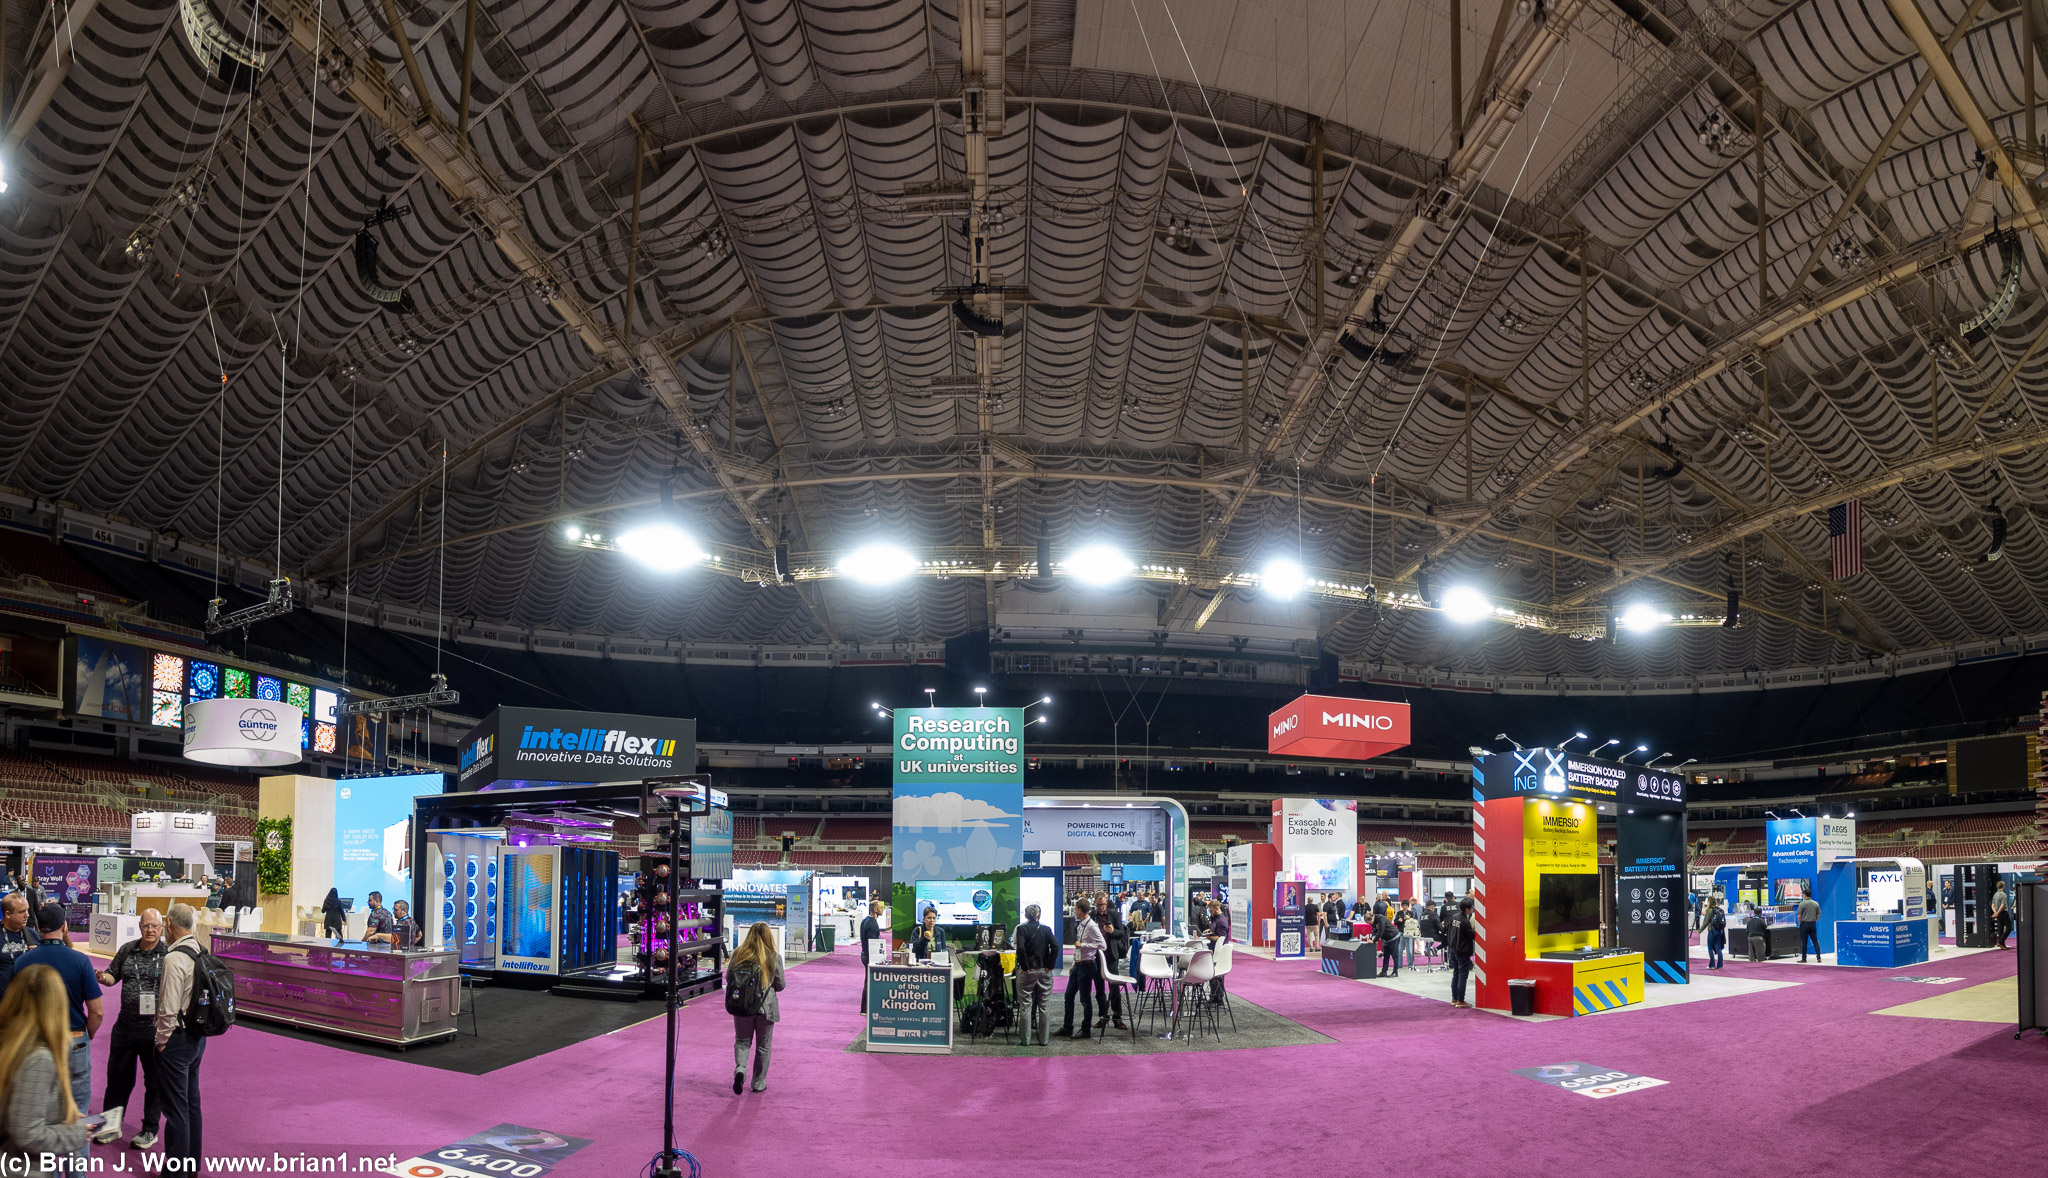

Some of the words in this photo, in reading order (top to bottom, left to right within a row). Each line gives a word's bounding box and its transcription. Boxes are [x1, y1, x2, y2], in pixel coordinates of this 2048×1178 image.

[95, 530, 113, 543] 454
[184, 555, 199, 568] 401
[408, 618, 422, 628] 404
[483, 631, 497, 641] 405
[561, 640, 575, 649] 406
[638, 647, 652, 655] 407
[715, 651, 729, 659] 408
[792, 652, 806, 660] 409
[870, 652, 882, 660] 410
[926, 651, 937, 660] 411
[1918, 657, 1930, 667] 425
[1854, 667, 1867, 675] 424
[1788, 674, 1801, 682] 423
[1722, 680, 1735, 688] 422
[239, 720, 277, 730] Güntner
[908, 716, 1011, 733] Research
[1323, 711, 1393, 730] MINIO
[1273, 714, 1299, 739] MINIO
[519, 725, 658, 756] intelliflex
[900, 733, 1018, 754] Computing
[516, 750, 581, 763] Innovative
[585, 753, 614, 764] Data
[617, 755, 673, 769] Solutions
[953, 753, 964, 761] at
[900, 761, 923, 773] UK
[927, 761, 1018, 773] universities
[1568, 760, 1603, 775] IMMERSION
[1603, 767, 1626, 779] COOLED
[1568, 772, 1595, 785] BATTERY
[1596, 777, 1619, 788] BACKUP
[1288, 817, 1326, 826] Exascale
[1328, 818, 1336, 826] AI
[1288, 826, 1308, 835] Data
[1311, 827, 1334, 835] Store
[1775, 832, 1811, 845] AIRSYS
[104, 862, 118, 871] pts
[728, 883, 787, 892] INNOVATES
[95, 928, 111, 937] Güntner
[502, 960, 543, 971] intelliflex
[873, 972, 946, 983] Universities
[888, 989, 929, 1000] United
[881, 999, 936, 1011] Kingdom
[1560, 1071, 1629, 1088] 6500
[437, 1148, 543, 1177] 6400
